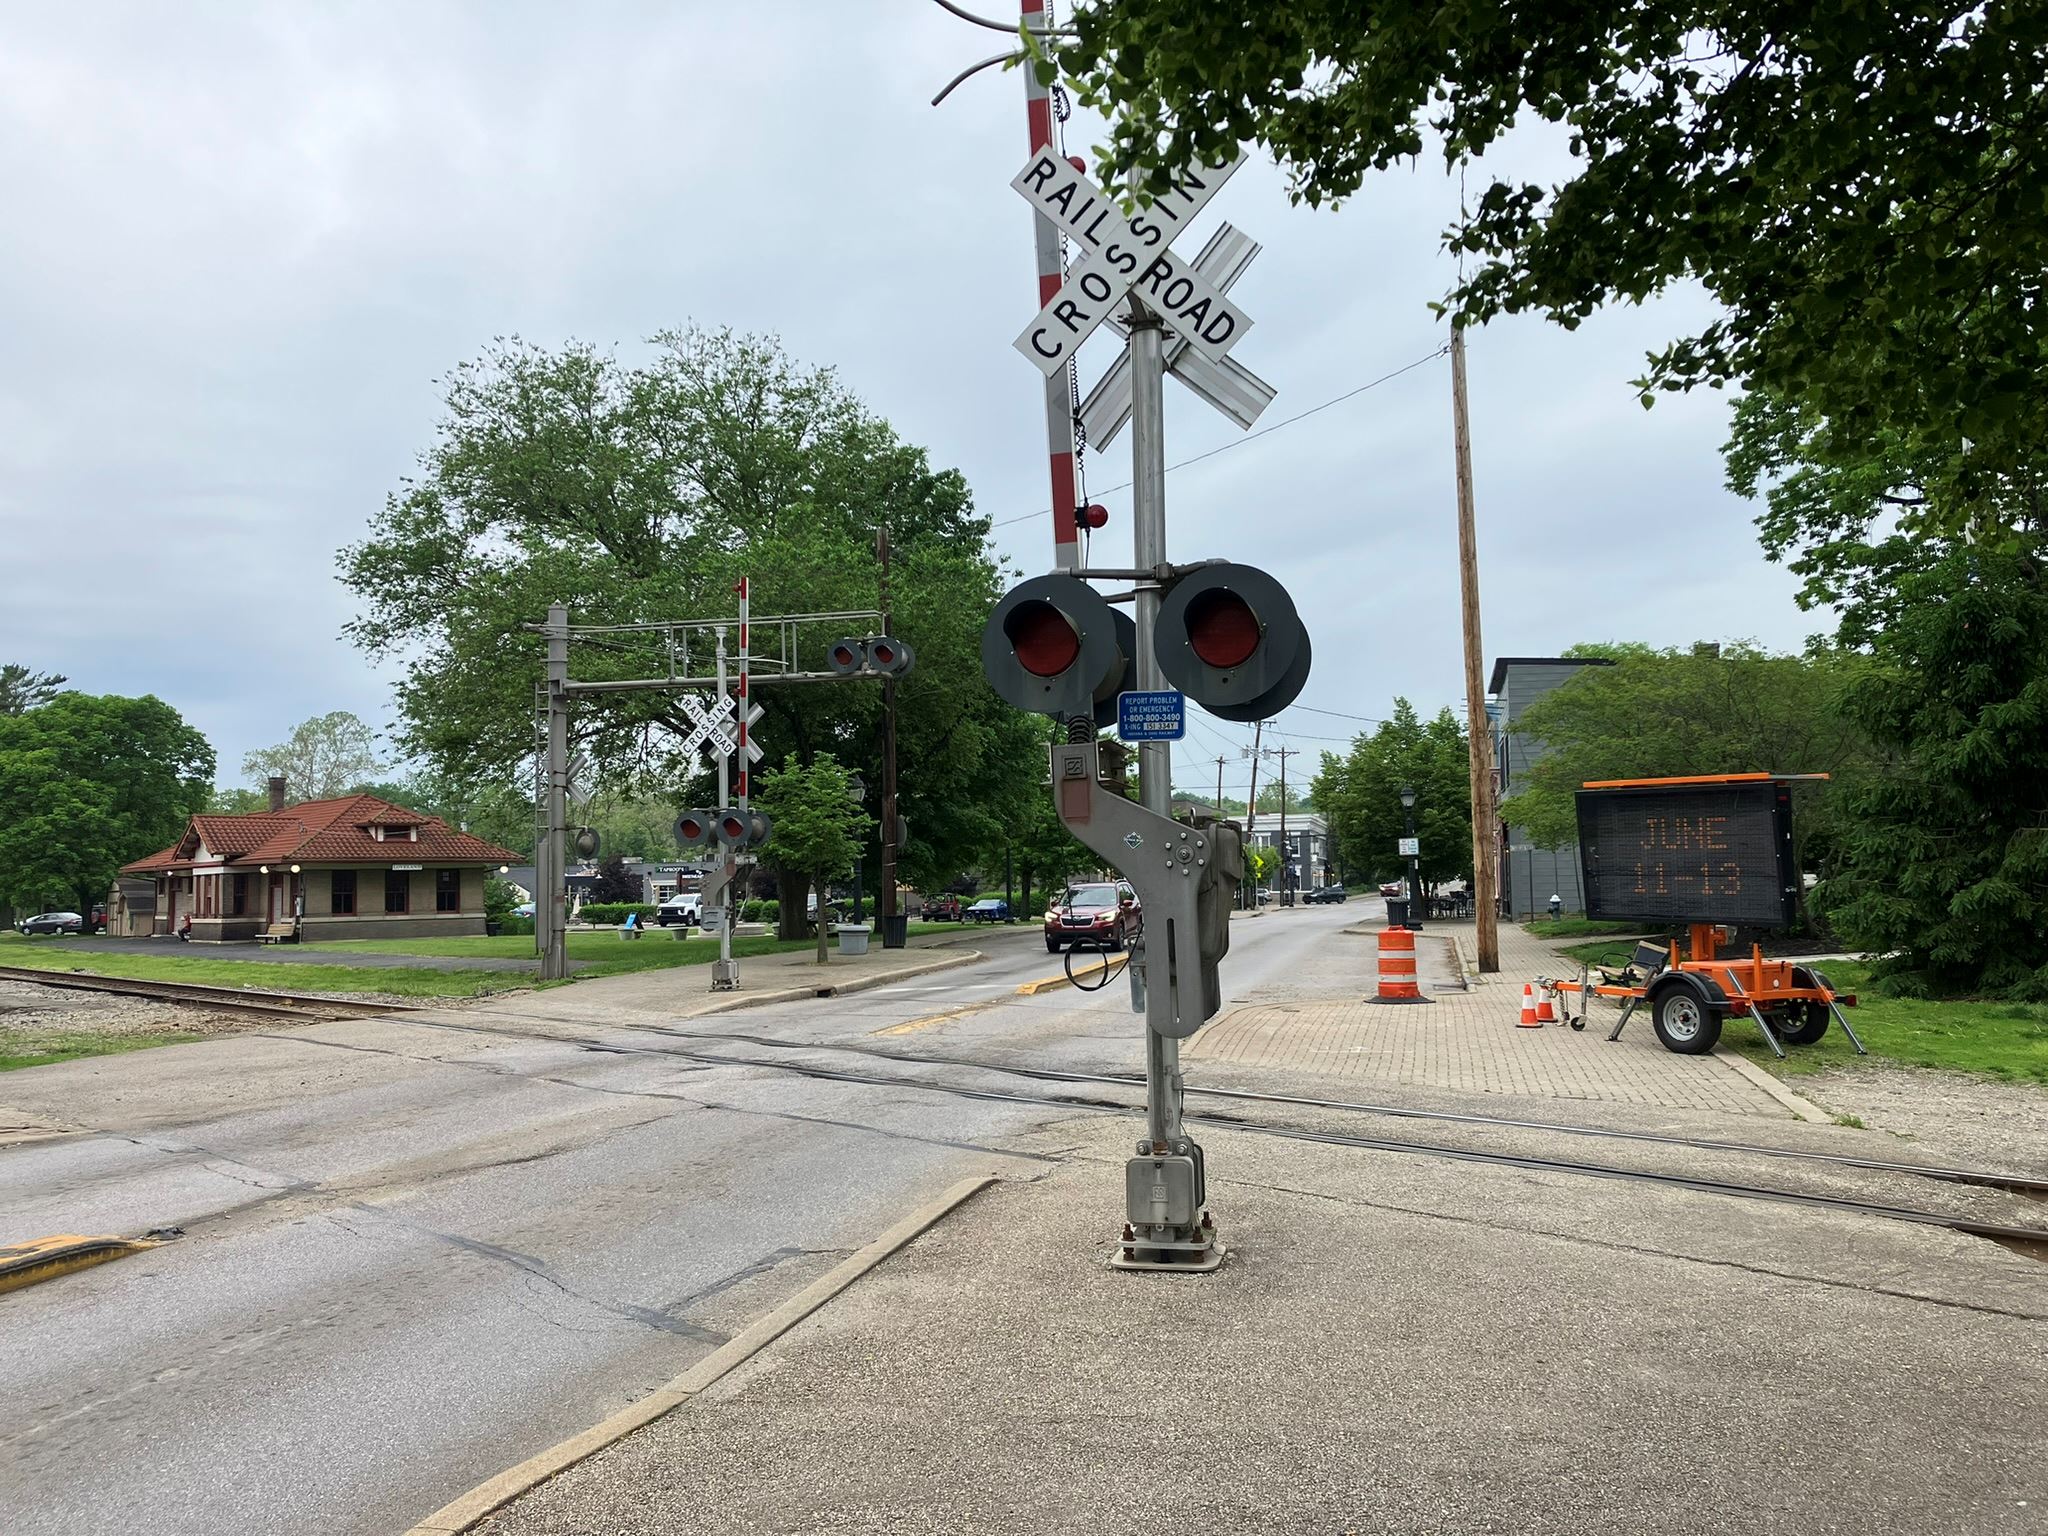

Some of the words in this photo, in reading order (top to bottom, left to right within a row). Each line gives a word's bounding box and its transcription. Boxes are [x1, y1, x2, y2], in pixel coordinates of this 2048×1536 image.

[1022, 156, 1109, 246] RAIL
[1138, 257, 1235, 345] ROAD
[1031, 155, 1230, 359] CROSSIN
[1125, 697, 1148, 705] REPORT
[1150, 696, 1177, 704] PROBLEM
[1140, 705, 1175, 713] EMERGENCY
[682, 698, 732, 754] CROSSING
[683, 699, 703, 724] RAIL
[708, 728, 732, 753] ROAD
[1123, 713, 1181, 722] 1-800-800-3490
[1640, 817, 1729, 849] JUNE
[1634, 862, 1741, 895] 11-13
